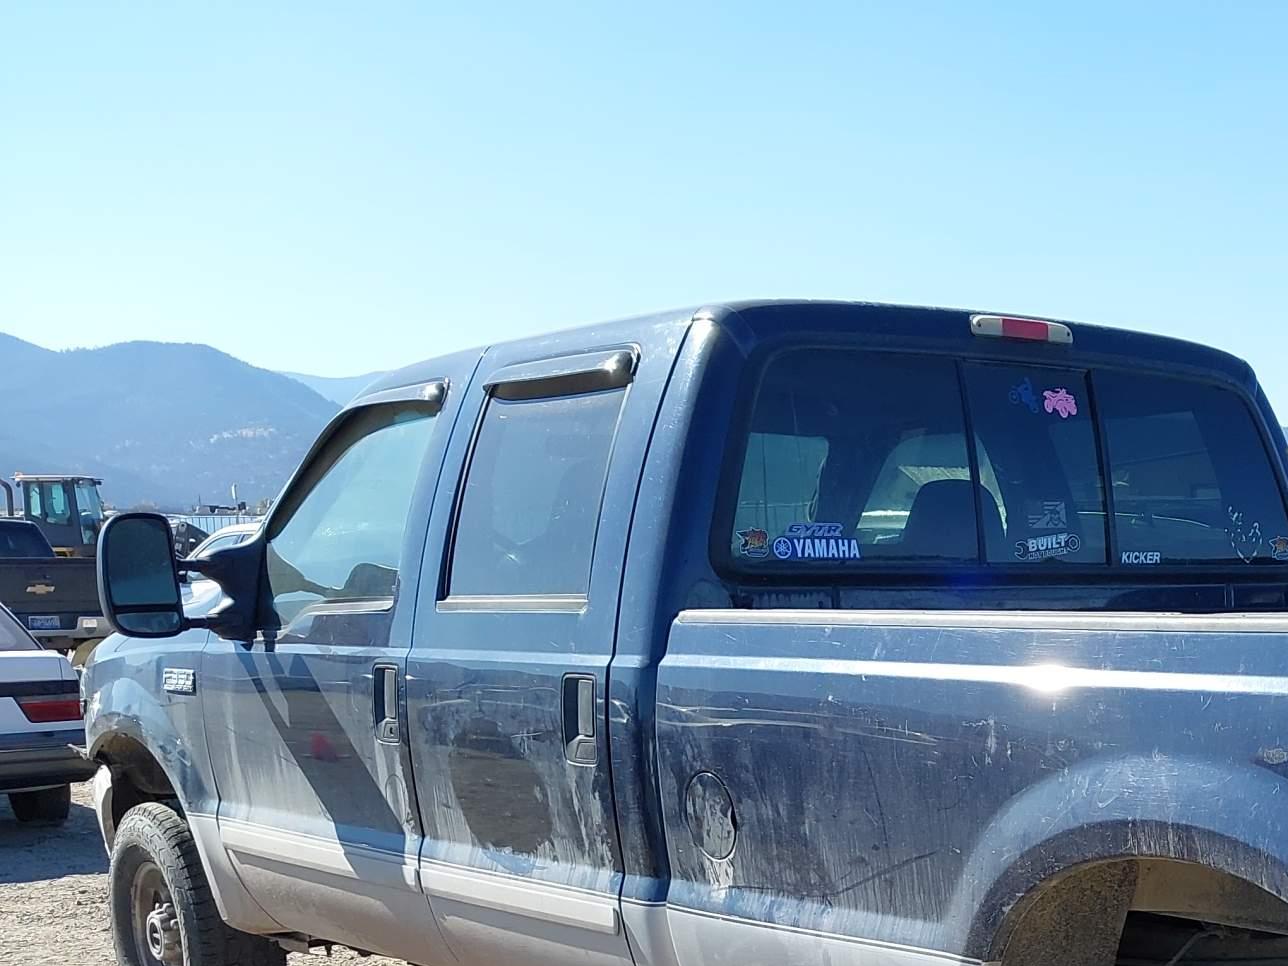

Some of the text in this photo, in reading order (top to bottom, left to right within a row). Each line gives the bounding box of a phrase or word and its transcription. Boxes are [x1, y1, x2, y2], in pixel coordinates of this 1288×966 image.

[793, 538, 860, 558] YAMAHA
[1027, 532, 1068, 552] BUILT
[1121, 551, 1161, 564] KICKER
